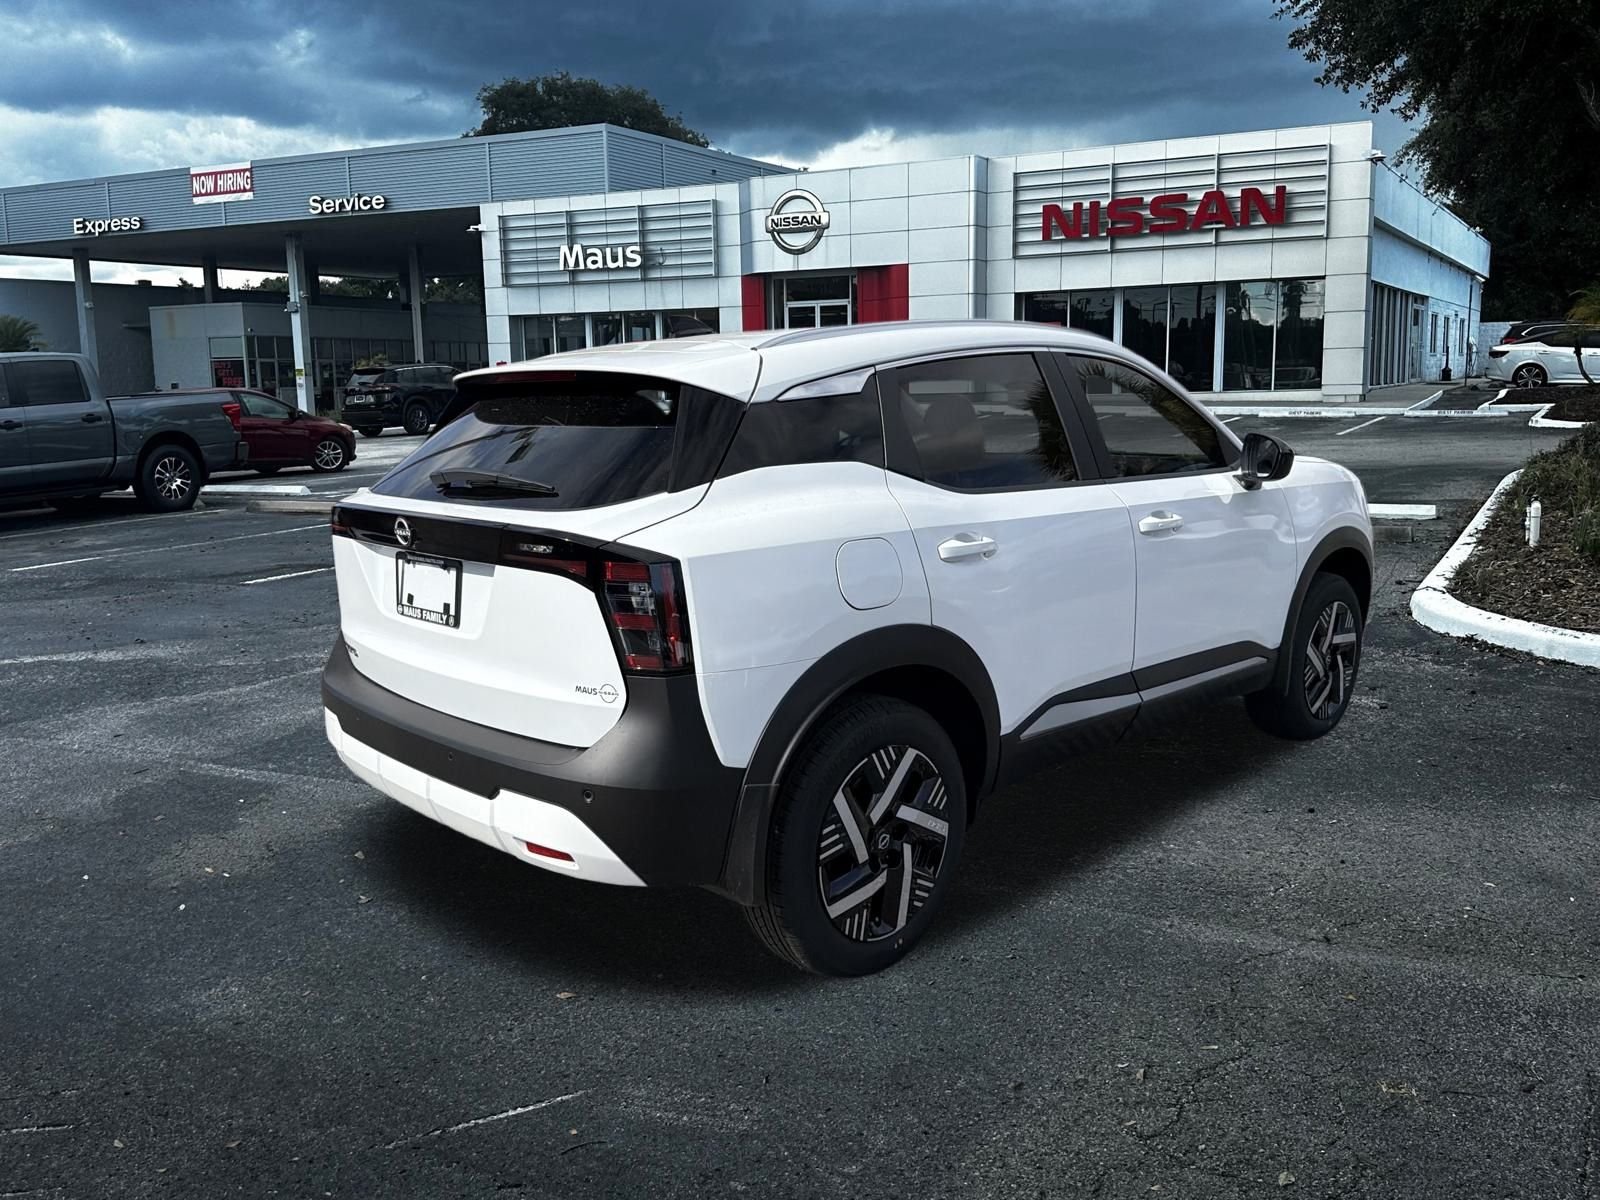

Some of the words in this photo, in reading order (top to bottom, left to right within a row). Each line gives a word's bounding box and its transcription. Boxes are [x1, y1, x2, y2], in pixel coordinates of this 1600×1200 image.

[192, 174, 215, 195] NOW
[217, 171, 251, 193] HIRING
[308, 192, 385, 215] Service
[1042, 185, 1287, 241] NISSAN
[73, 216, 141, 237] Express
[770, 215, 822, 228] NISSAN
[559, 243, 642, 271] Maus
[403, 606, 422, 619] MAUS
[422, 609, 448, 625] FAMILY
[575, 685, 598, 696] MAUS
